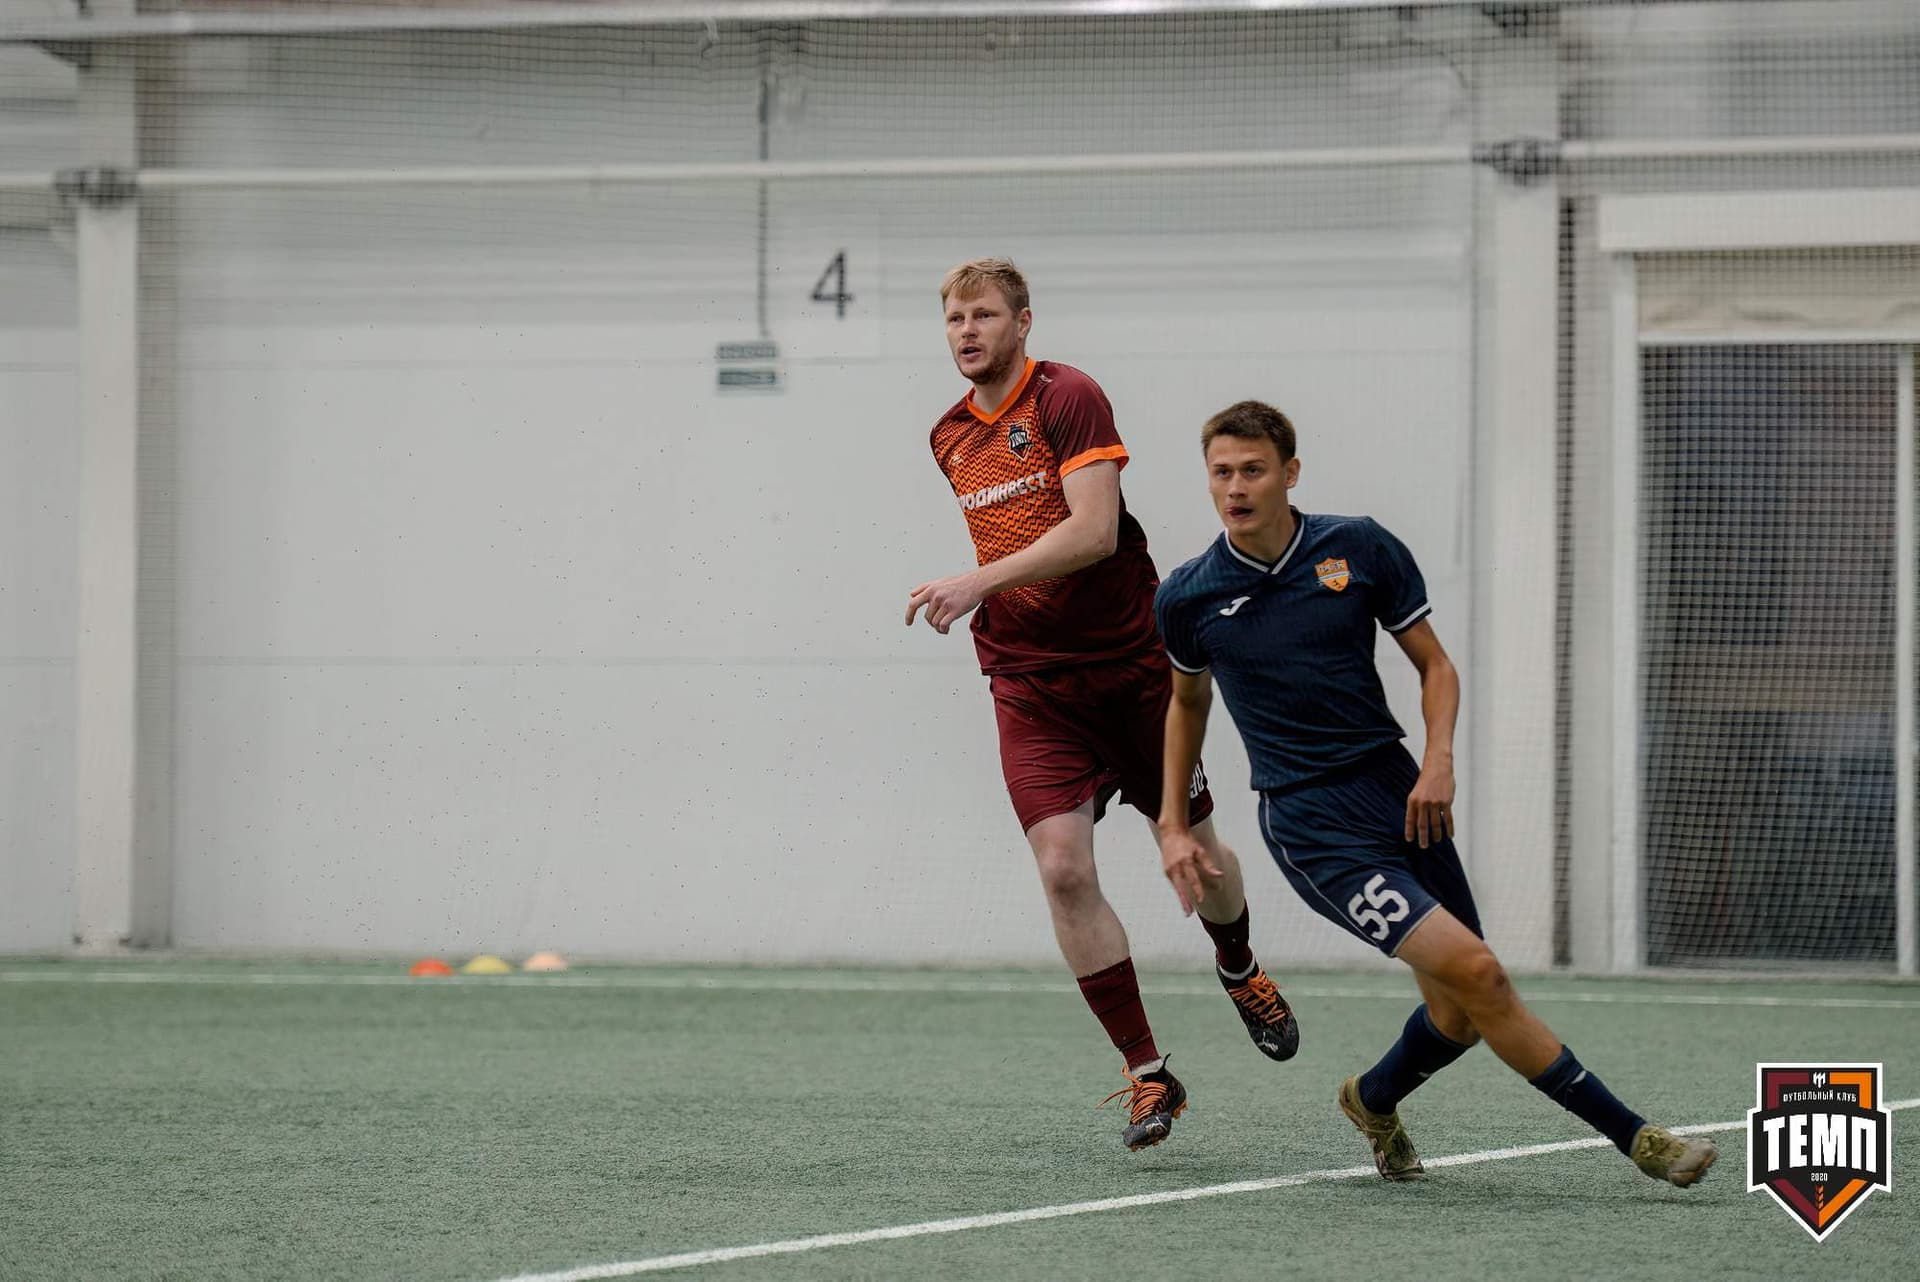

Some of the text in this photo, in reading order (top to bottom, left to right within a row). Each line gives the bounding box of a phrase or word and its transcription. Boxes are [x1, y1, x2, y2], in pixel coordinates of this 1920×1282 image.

[811, 250, 854, 320] 4
[959, 471, 1047, 510] ОДИНВЕСТ
[1348, 873, 1410, 941] 55
